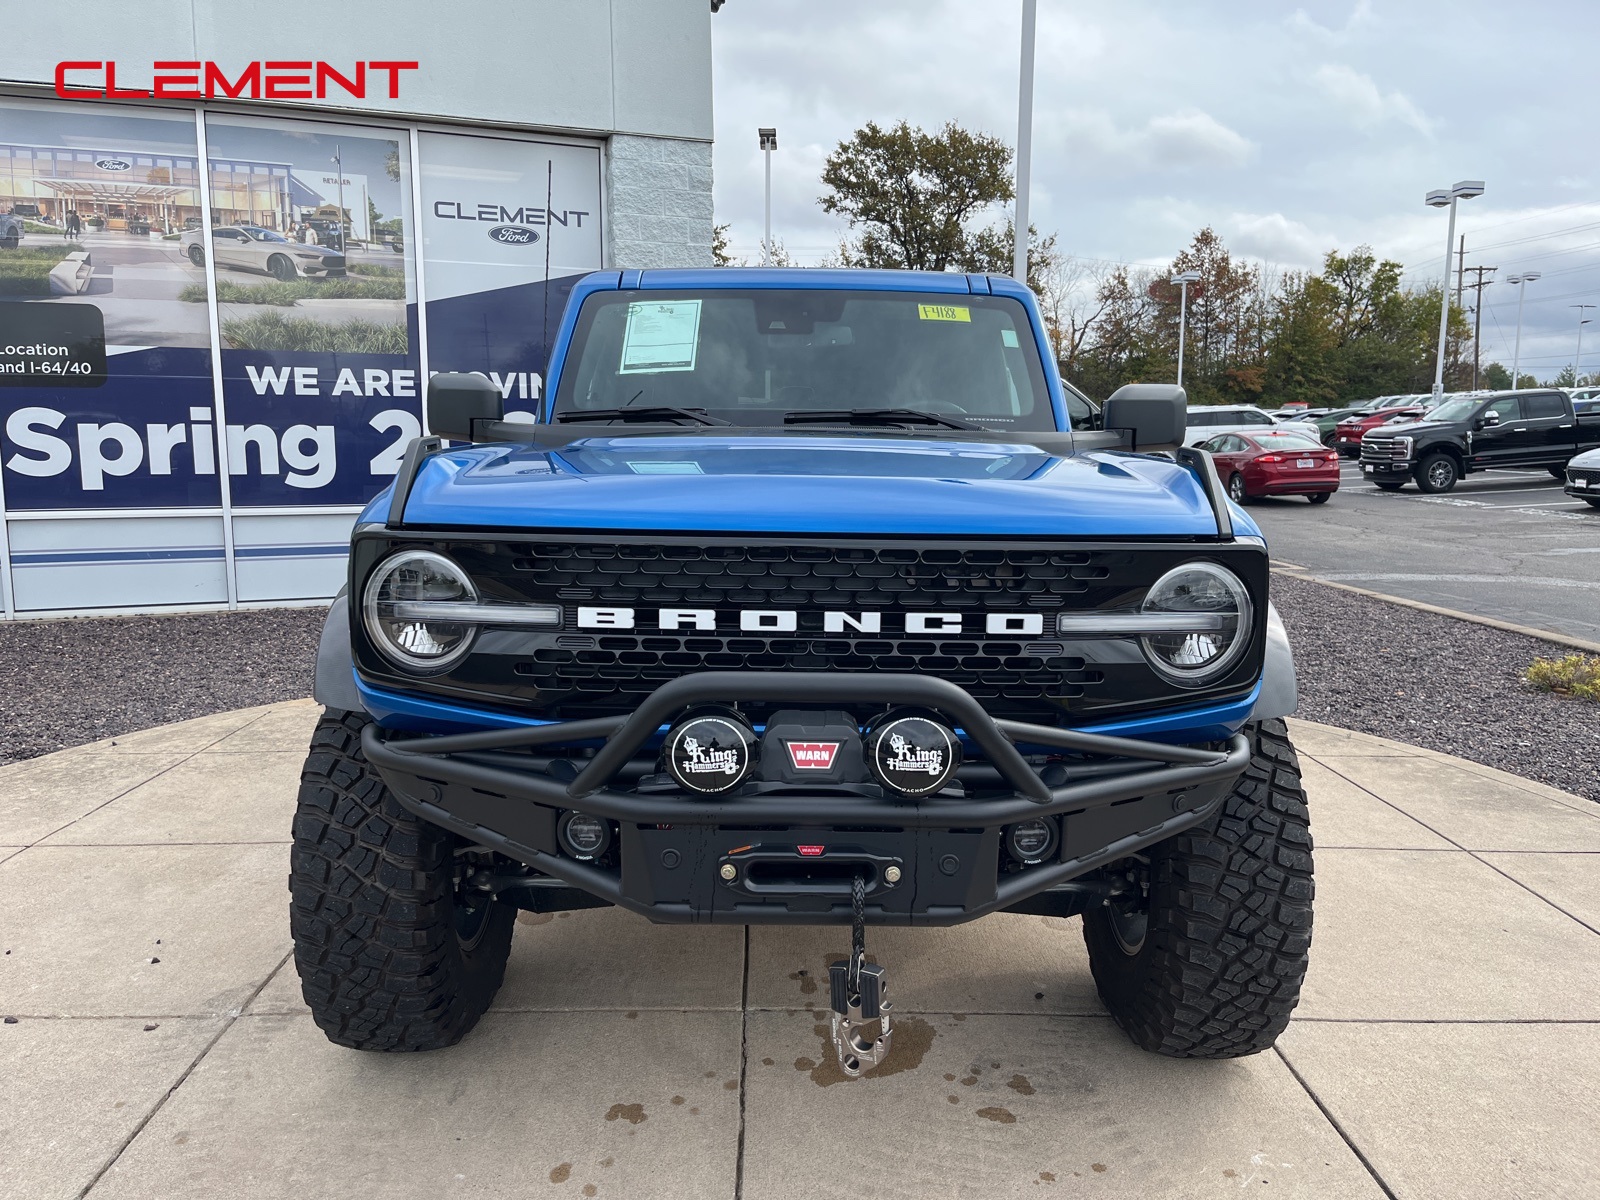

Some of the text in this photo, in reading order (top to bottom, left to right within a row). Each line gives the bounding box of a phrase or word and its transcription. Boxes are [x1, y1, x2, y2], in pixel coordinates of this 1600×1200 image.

[102, 160, 126, 170] Ford
[434, 200, 590, 228] CLEMENT
[498, 227, 530, 243] Ford
[30, 360, 92, 376] I-64/40
[245, 365, 320, 396] WE
[331, 367, 417, 397] ARE
[6, 406, 337, 491] Spring
[577, 606, 1044, 635] BRONCO
[688, 746, 732, 763] King
[795, 750, 830, 761] WARN
[893, 744, 938, 764] King
